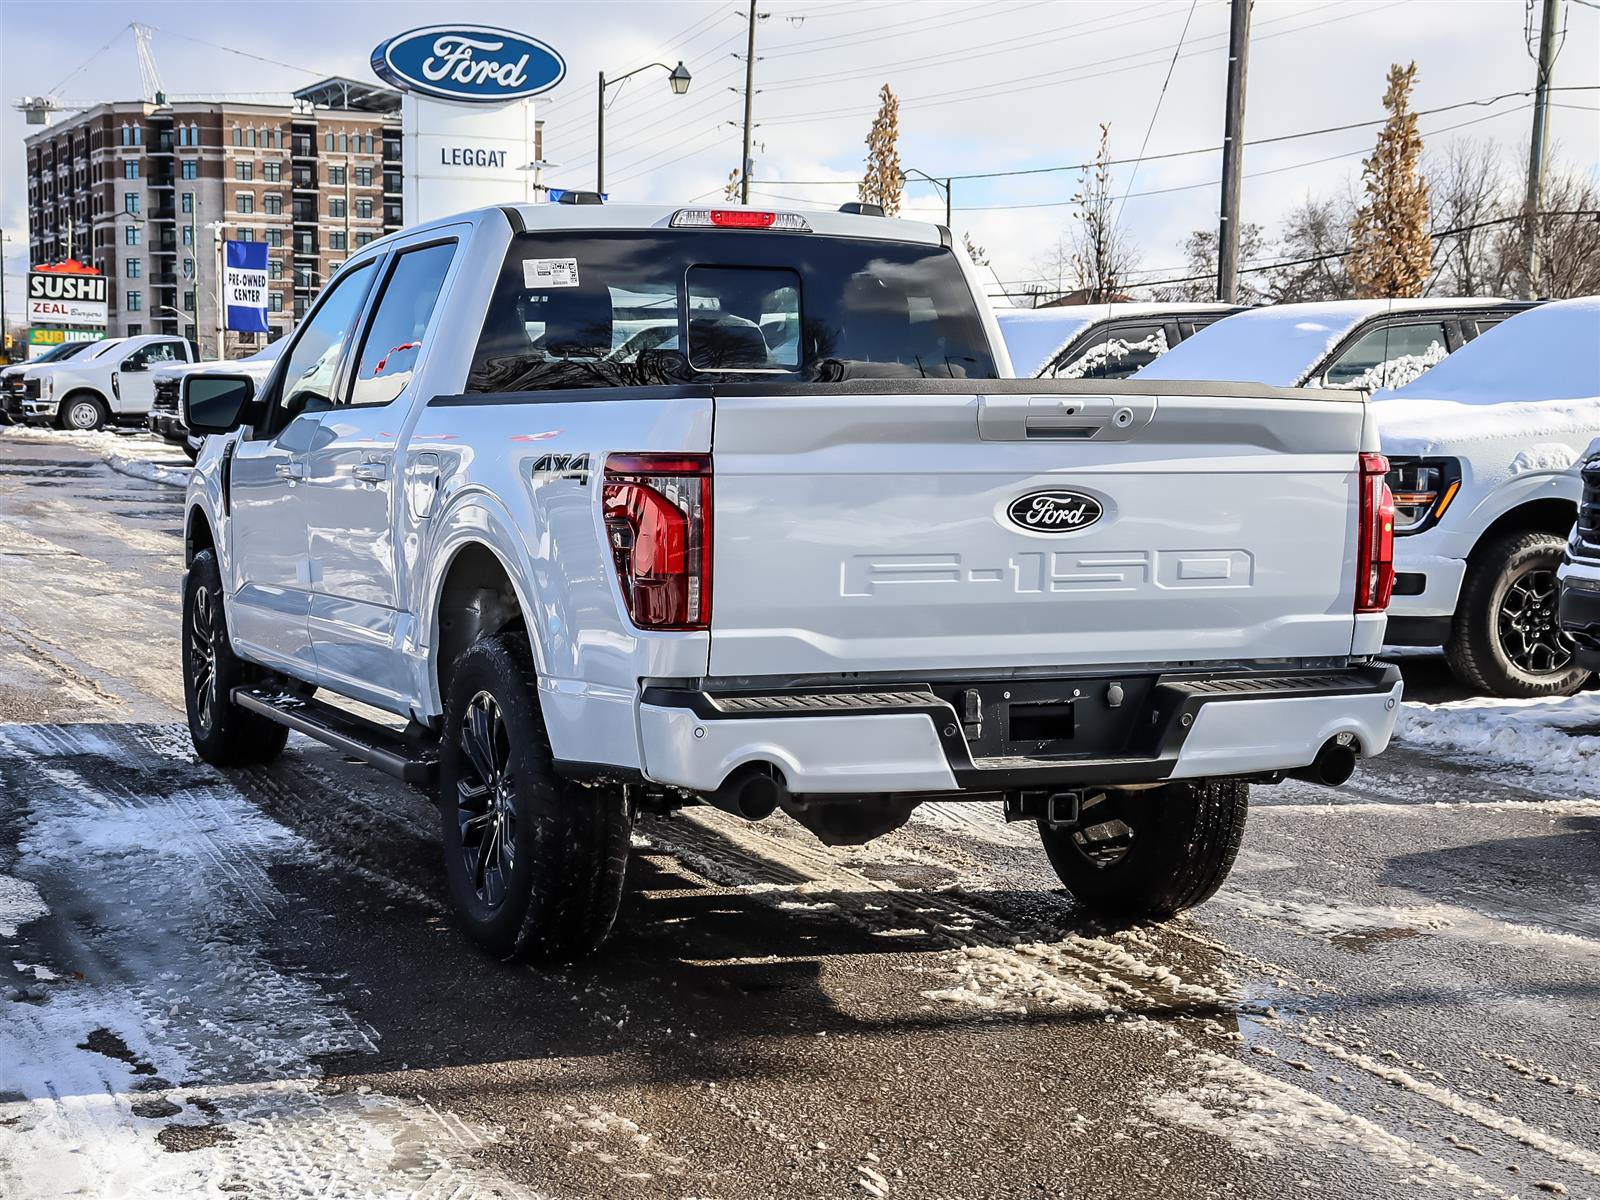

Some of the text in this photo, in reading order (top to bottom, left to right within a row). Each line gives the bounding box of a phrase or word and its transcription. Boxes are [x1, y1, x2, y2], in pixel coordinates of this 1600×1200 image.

[422, 35, 530, 88] Ford
[441, 148, 508, 168] LEGGAT
[31, 276, 104, 300] SUSHI
[228, 273, 266, 288] PRE-OWNED
[234, 288, 261, 302] CENTER
[33, 302, 68, 315] ZEAL
[32, 330, 104, 344] SUBWAY
[1026, 496, 1087, 524] Ford
[840, 548, 1256, 598] F-150
